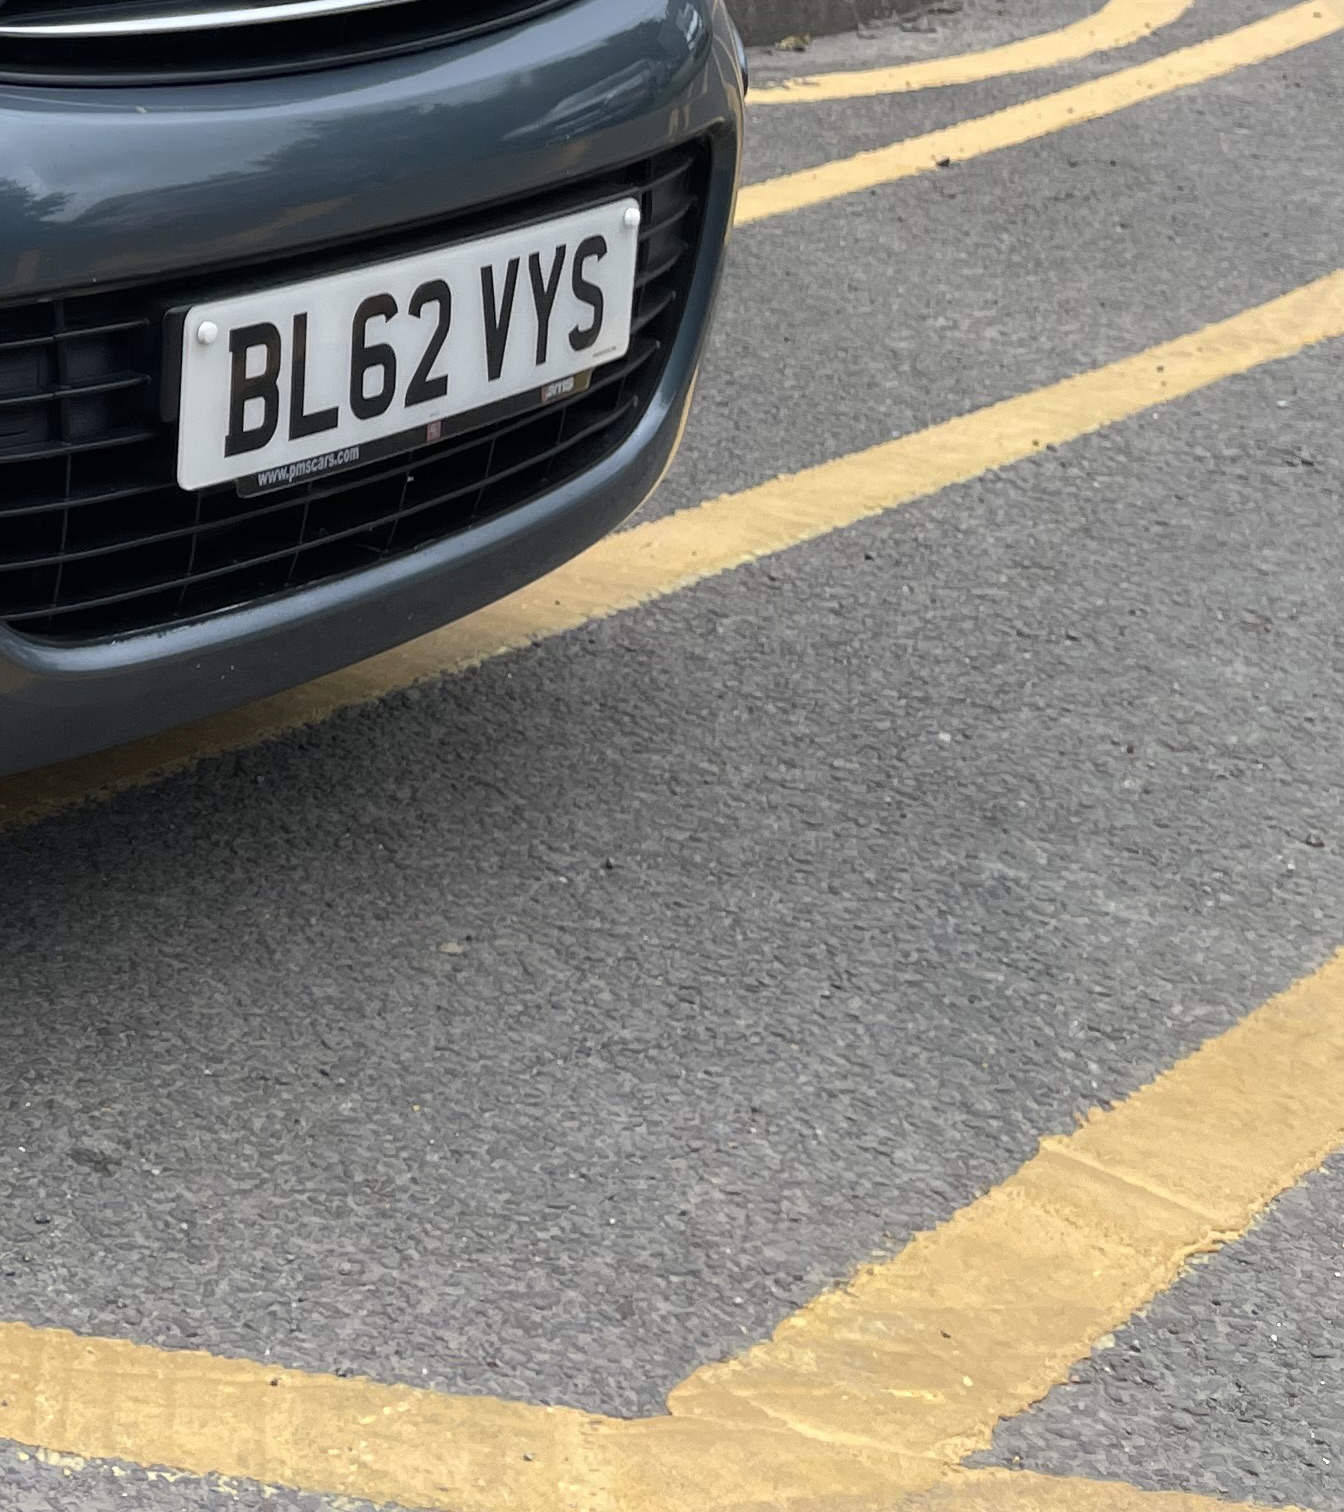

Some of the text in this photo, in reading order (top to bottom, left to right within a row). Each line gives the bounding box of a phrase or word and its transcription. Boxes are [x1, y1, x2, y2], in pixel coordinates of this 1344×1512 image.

[224, 234, 608, 458] BL62 VYS
[256, 445, 360, 487] www.pmscars.com
